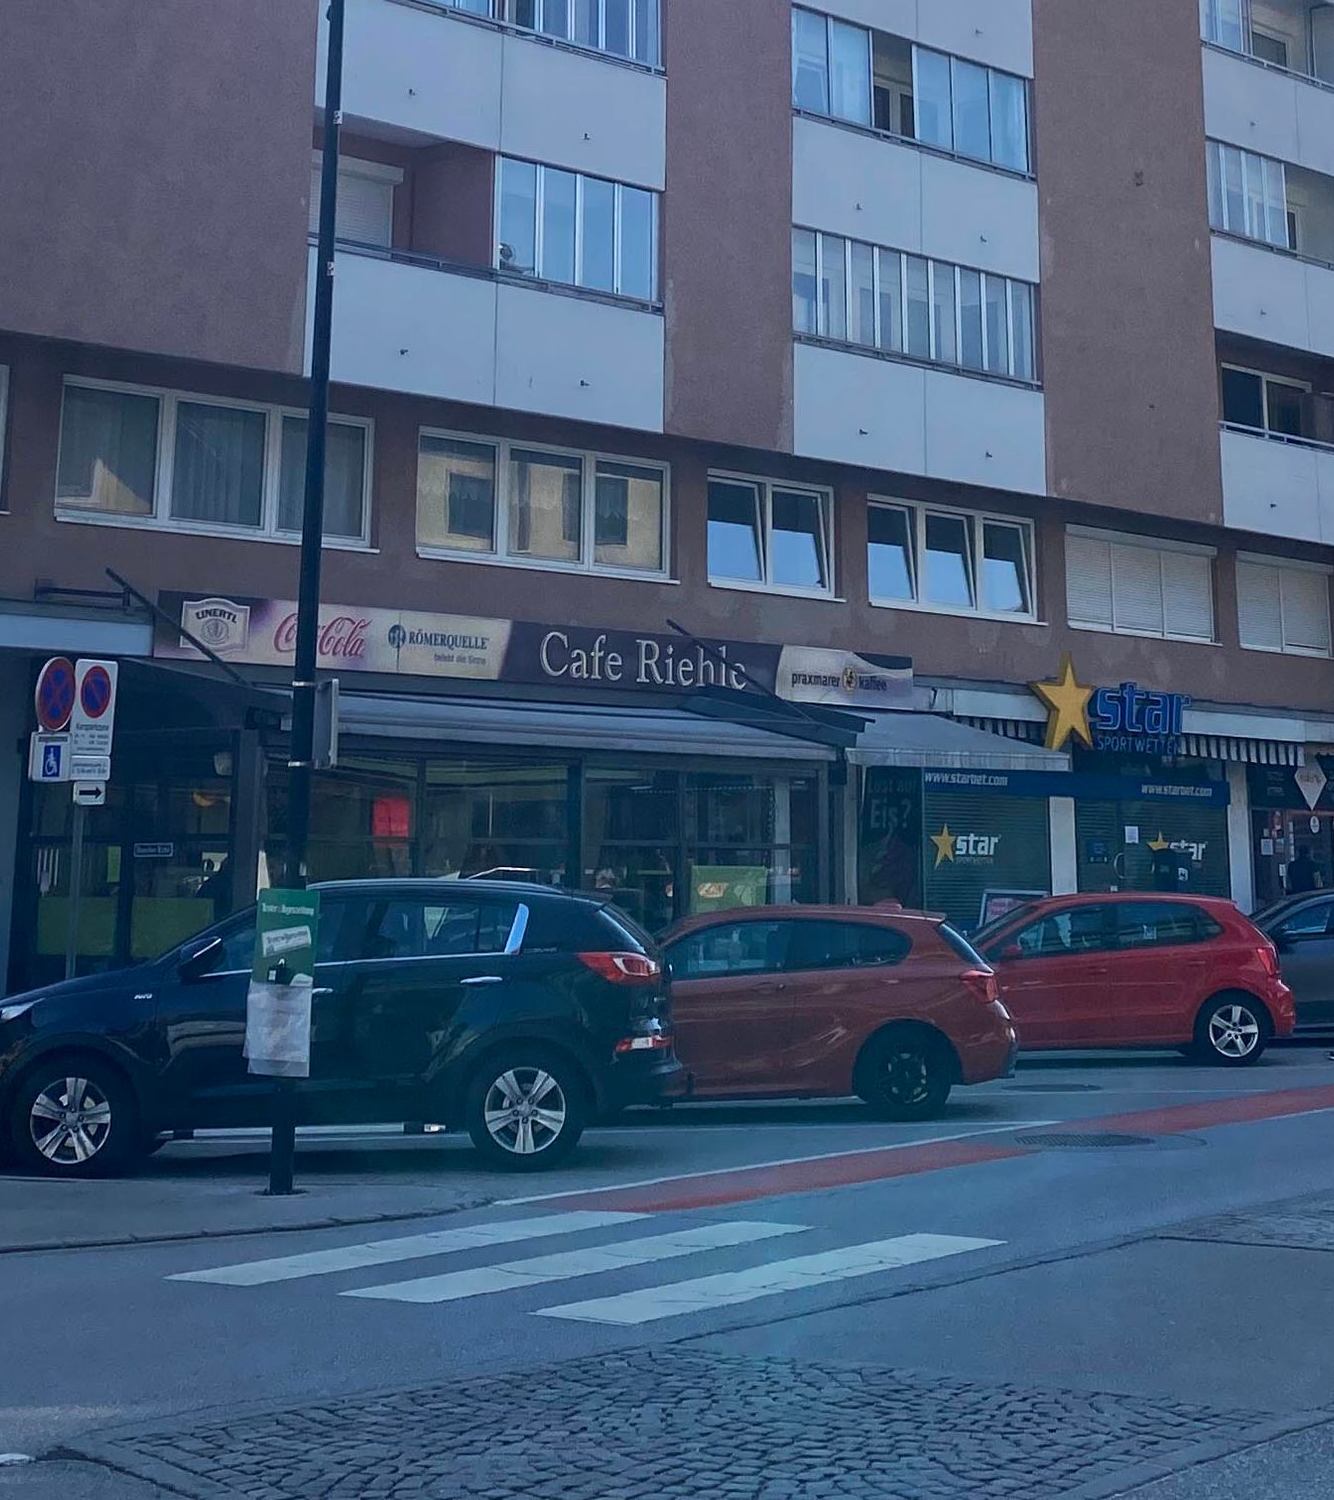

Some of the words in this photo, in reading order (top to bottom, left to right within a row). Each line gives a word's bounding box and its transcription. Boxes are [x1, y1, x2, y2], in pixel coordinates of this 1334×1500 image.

[195, 608, 238, 625] UNERTL
[408, 628, 488, 651] RÖMERQUELLE
[540, 631, 623, 681] Cafe
[635, 639, 749, 690] Riehle
[791, 672, 841, 688] praxmarer
[1091, 682, 1192, 736] star
[870, 798, 911, 829] Eis?
[955, 832, 999, 855] star
